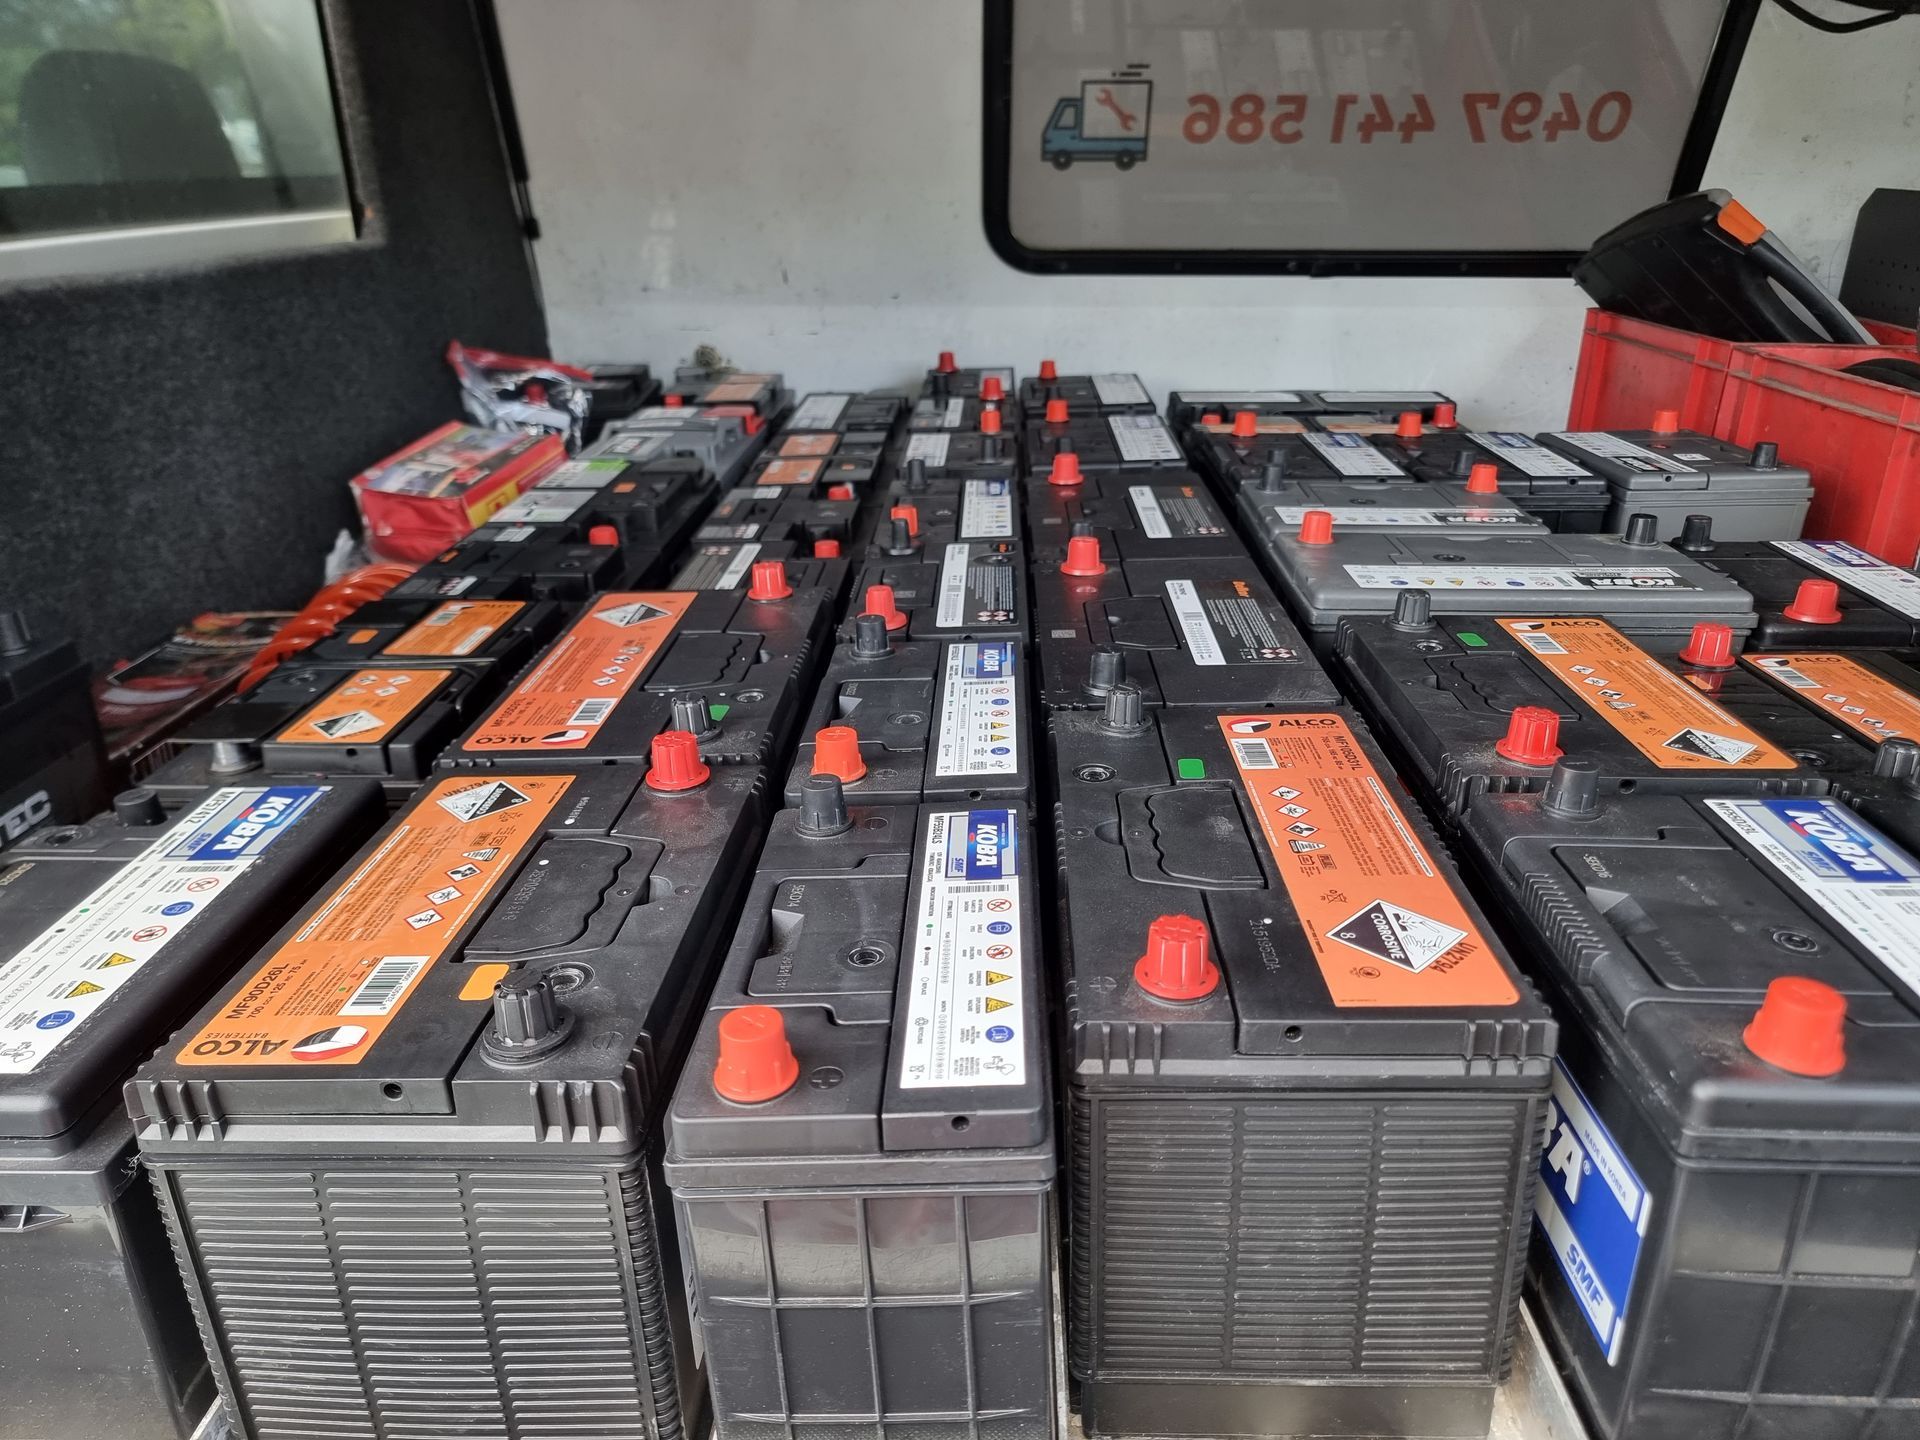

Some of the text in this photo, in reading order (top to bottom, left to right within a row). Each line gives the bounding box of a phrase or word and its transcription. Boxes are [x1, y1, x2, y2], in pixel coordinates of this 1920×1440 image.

[1590, 577, 1676, 587] KOBA
[1550, 620, 1601, 628] ALCO
[984, 649, 1000, 671] KOBA
[1794, 656, 1841, 664] ALCO
[1279, 718, 1336, 727] ALCO
[476, 736, 536, 745] ALCO
[442, 780, 490, 797] UN2794
[477, 787, 506, 815] CORROSIVE
[0, 790, 51, 842] EC
[184, 791, 232, 826] MF57412
[1712, 801, 1760, 836] MF55D23L
[213, 795, 296, 852] KOBA
[932, 815, 945, 844] MF55B24LS
[188, 832, 212, 851] SMF
[976, 824, 998, 867] KOBA
[1785, 810, 1888, 871] KOBA
[954, 858, 965, 873] SMF
[1801, 850, 1837, 873] SMF
[1368, 913, 1405, 959] CORROSIVE
[1429, 942, 1478, 975] UN2794
[224, 963, 290, 1018] MF90D26L
[245, 1006, 265, 1018] 700
[268, 982, 287, 993] 125
[193, 1039, 288, 1055] ALCO
[1583, 1129, 1627, 1201] MADE IN KOREA
[1566, 1243, 1604, 1307] SMF
